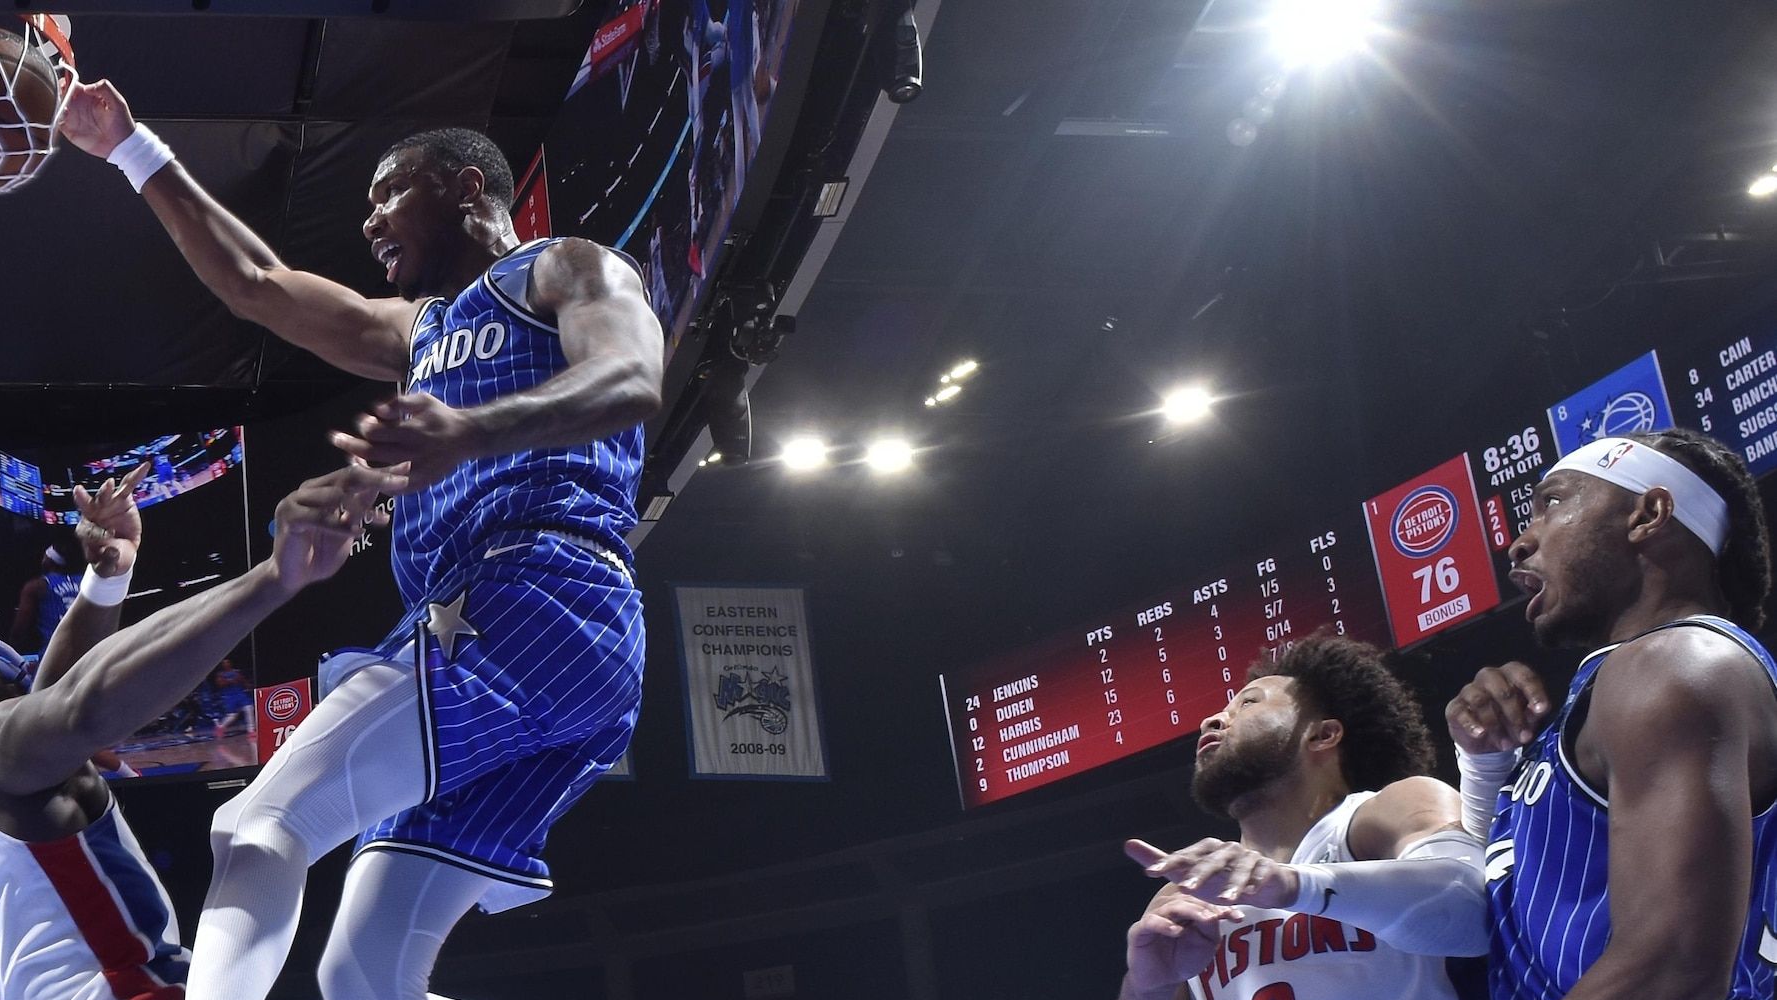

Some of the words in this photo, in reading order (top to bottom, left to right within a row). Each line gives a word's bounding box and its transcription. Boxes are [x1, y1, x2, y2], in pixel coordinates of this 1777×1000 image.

[1720, 337, 1751, 366] CAIN
[1483, 426, 1540, 473] 8:36
[1490, 467, 1515, 487] 4TH
[1516, 452, 1543, 474] QTR
[1403, 503, 1443, 530] DETROIT
[1406, 514, 1446, 540] PISTONS
[1087, 626, 1112, 646] PTS
[1137, 602, 1172, 626] REBS
[1194, 579, 1227, 604] ASTS
[1257, 558, 1275, 576] FG
[1310, 531, 1336, 553] FLS
[1413, 557, 1459, 604] 76
[707, 606, 777, 618] EASTERN
[1425, 600, 1464, 626] BONUS
[693, 624, 797, 637] CONFERENCE
[966, 696, 980, 711] 24
[993, 675, 1038, 702] JENKINS
[1261, 579, 1279, 597] 1/5
[702, 643, 792, 656] CHAMPIONS
[996, 698, 1034, 722] DUREN
[1101, 669, 1113, 683] 12
[1265, 599, 1282, 618] 5/7
[972, 737, 985, 751] 12
[1000, 717, 1041, 742] HARRIS
[1105, 689, 1117, 704] 15
[1267, 620, 1291, 641] 6/14
[731, 743, 785, 755] 2008-09
[1003, 724, 1080, 763] CUNNINGHAM
[1108, 709, 1121, 726] 23
[1006, 750, 1069, 782] THOMPSON
